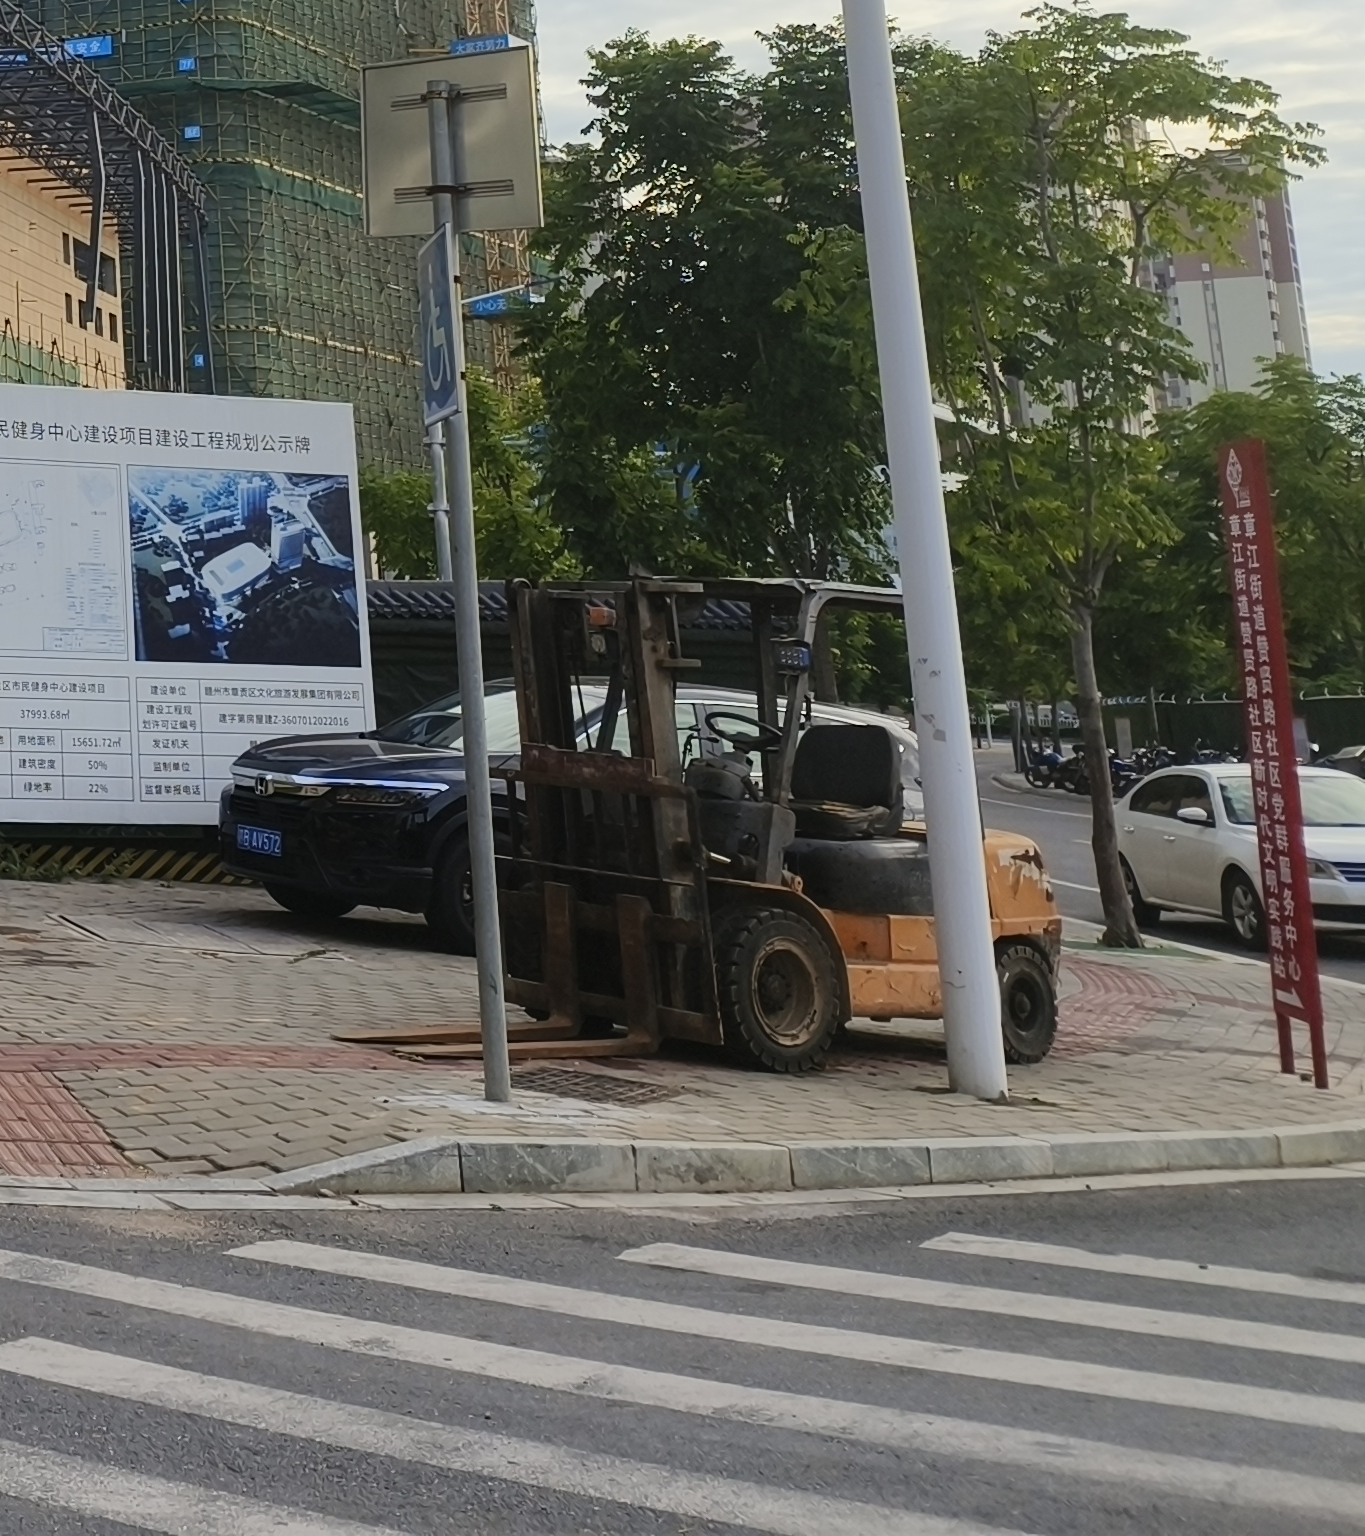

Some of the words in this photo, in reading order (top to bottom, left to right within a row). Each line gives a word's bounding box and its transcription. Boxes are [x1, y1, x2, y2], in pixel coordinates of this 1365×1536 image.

[150, 685, 187, 696] 建设单位
[146, 704, 192, 715] 建设工程规
[142, 719, 197, 730] 划许可证编号
[17, 735, 57, 746] 用地面积
[152, 738, 190, 750] 发证机关
[18, 758, 57, 770] 建筑密度
[88, 760, 108, 771] 50%
[153, 761, 191, 772] 监制单位
[23, 781, 53, 793] 绿地率
[88, 783, 109, 794] 22%
[145, 784, 201, 796] 监督举报电话
